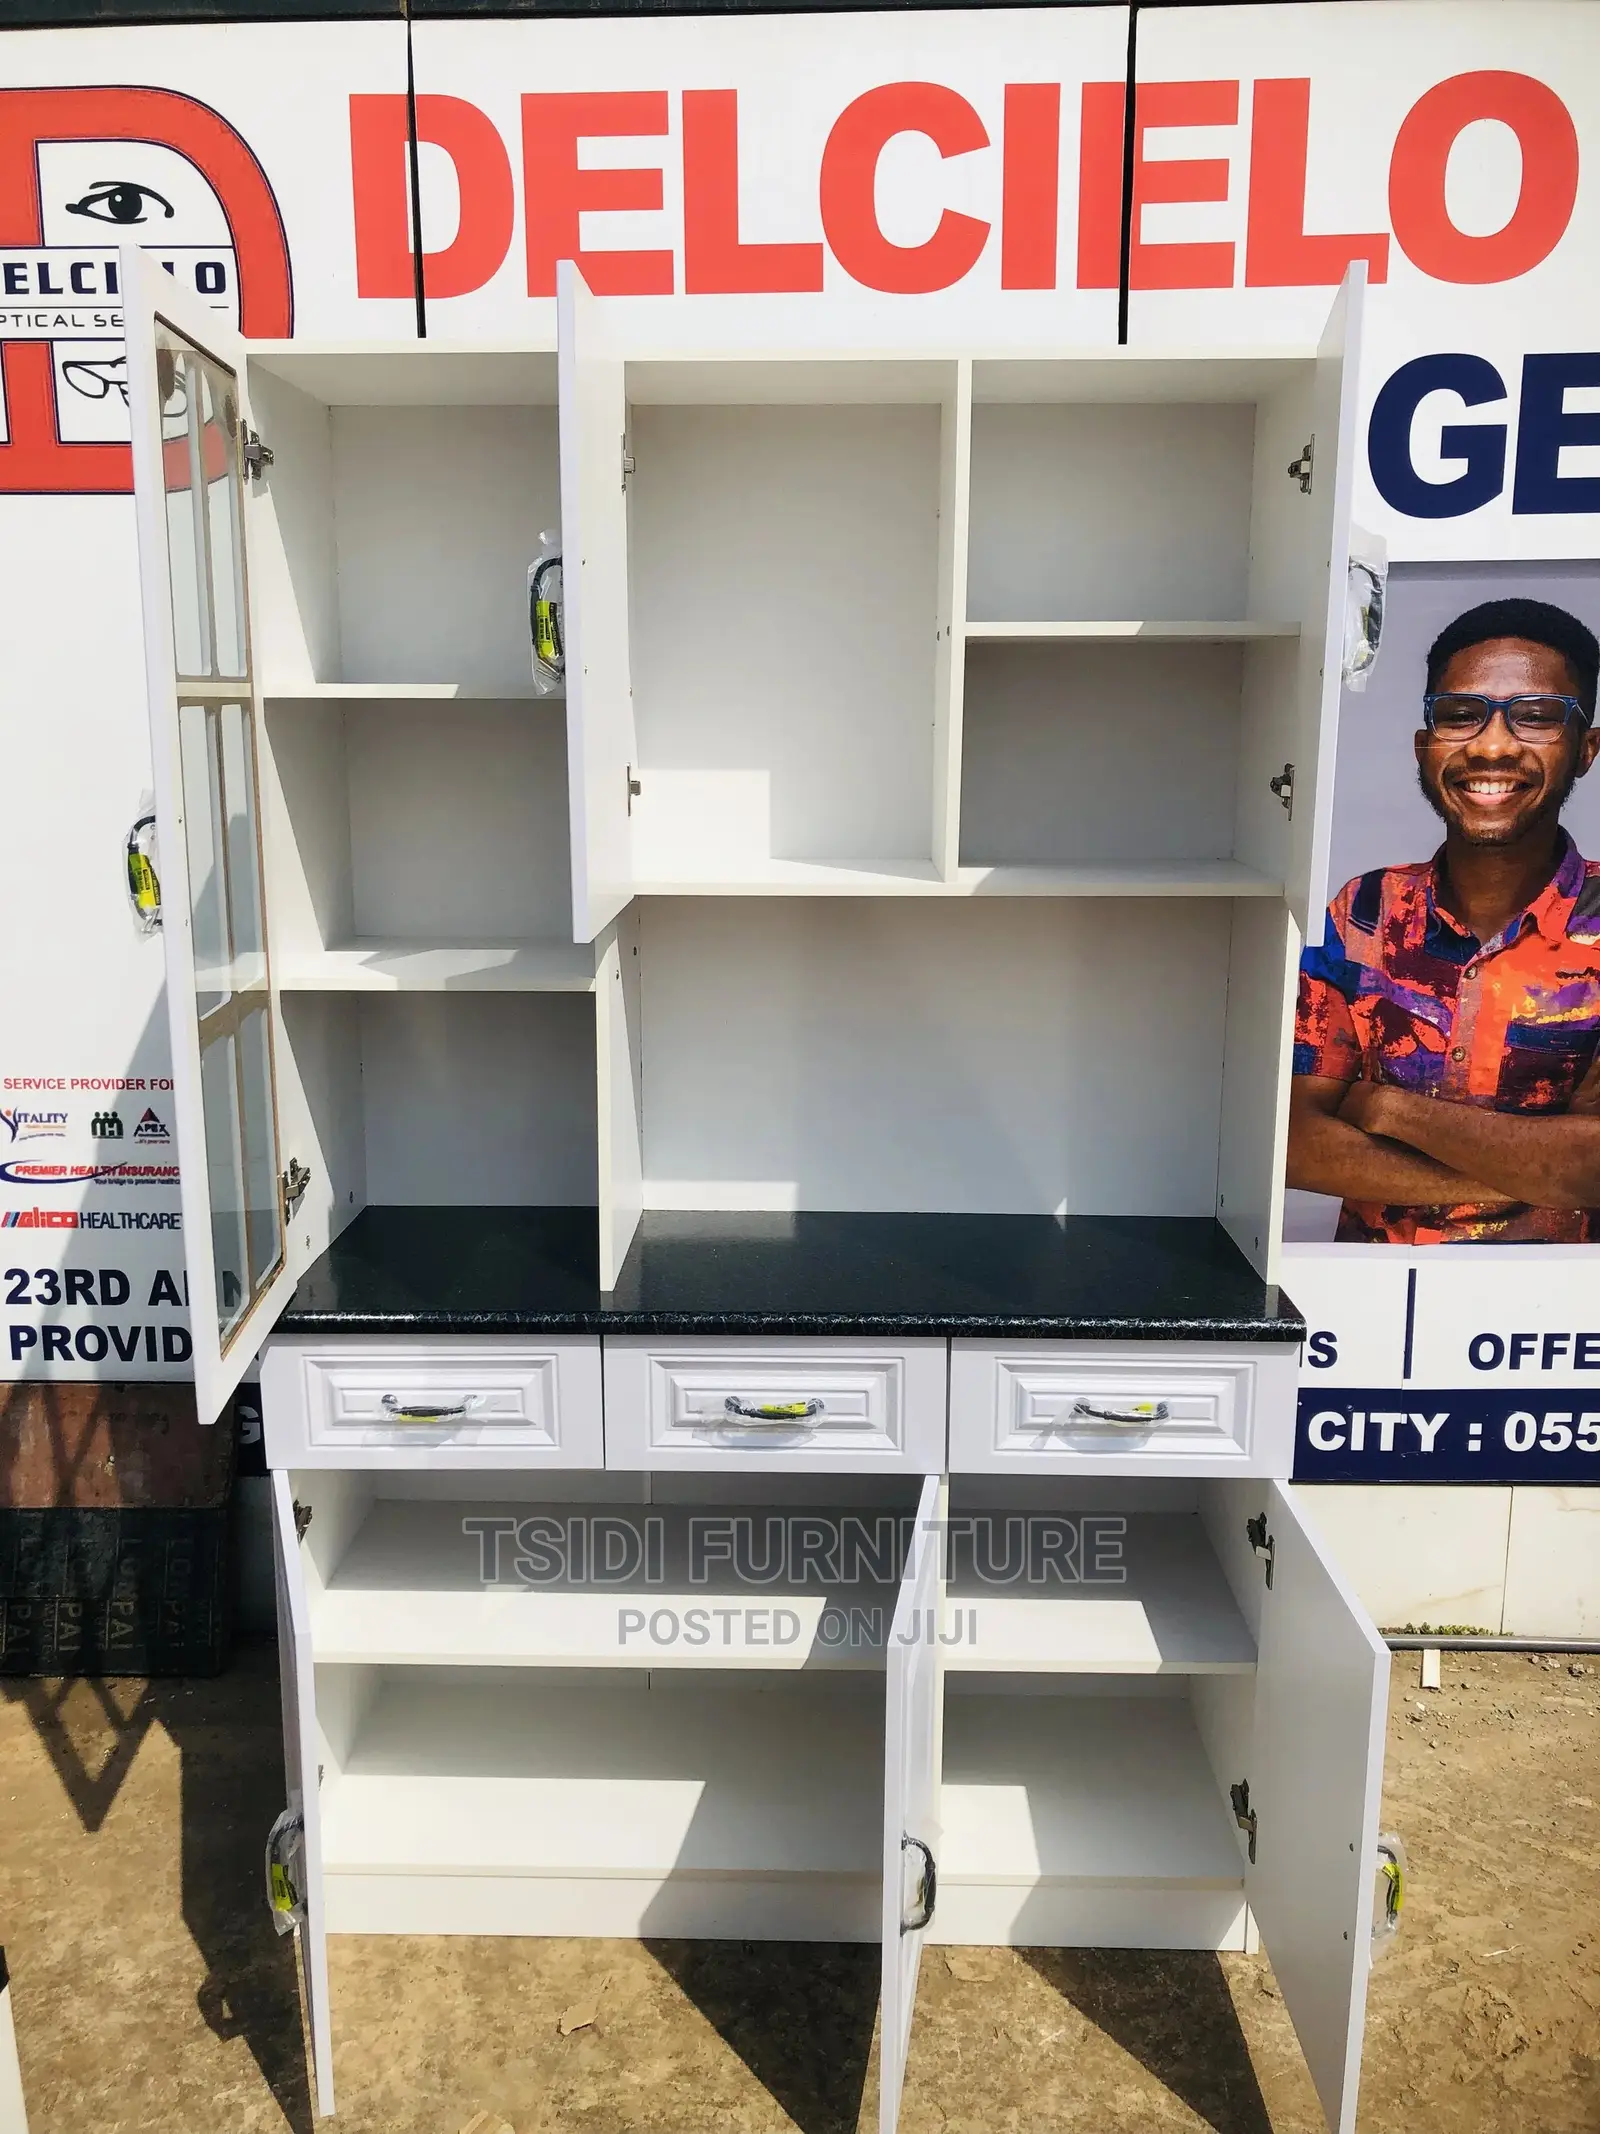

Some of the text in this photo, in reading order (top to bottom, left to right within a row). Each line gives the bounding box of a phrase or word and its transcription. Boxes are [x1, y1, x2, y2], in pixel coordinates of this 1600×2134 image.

[348, 70, 1579, 299] DELCIELO
[1367, 352, 1600, 519] GE
[4, 1078, 66, 1090] SERVICE
[71, 1078, 146, 1090] PROVIDER
[133, 1123, 171, 1137] APEX
[15, 1165, 67, 1176] PREMIER
[70, 1165, 118, 1176] HEALTH
[80, 1211, 182, 1230] HEALTHCARE
[4, 1268, 131, 1306] 23RD
[9, 1324, 193, 1362] PROVID
[1468, 1332, 1600, 1371] OFFE
[1308, 1411, 1450, 1452] CITY
[1504, 1411, 1600, 1452] 055
